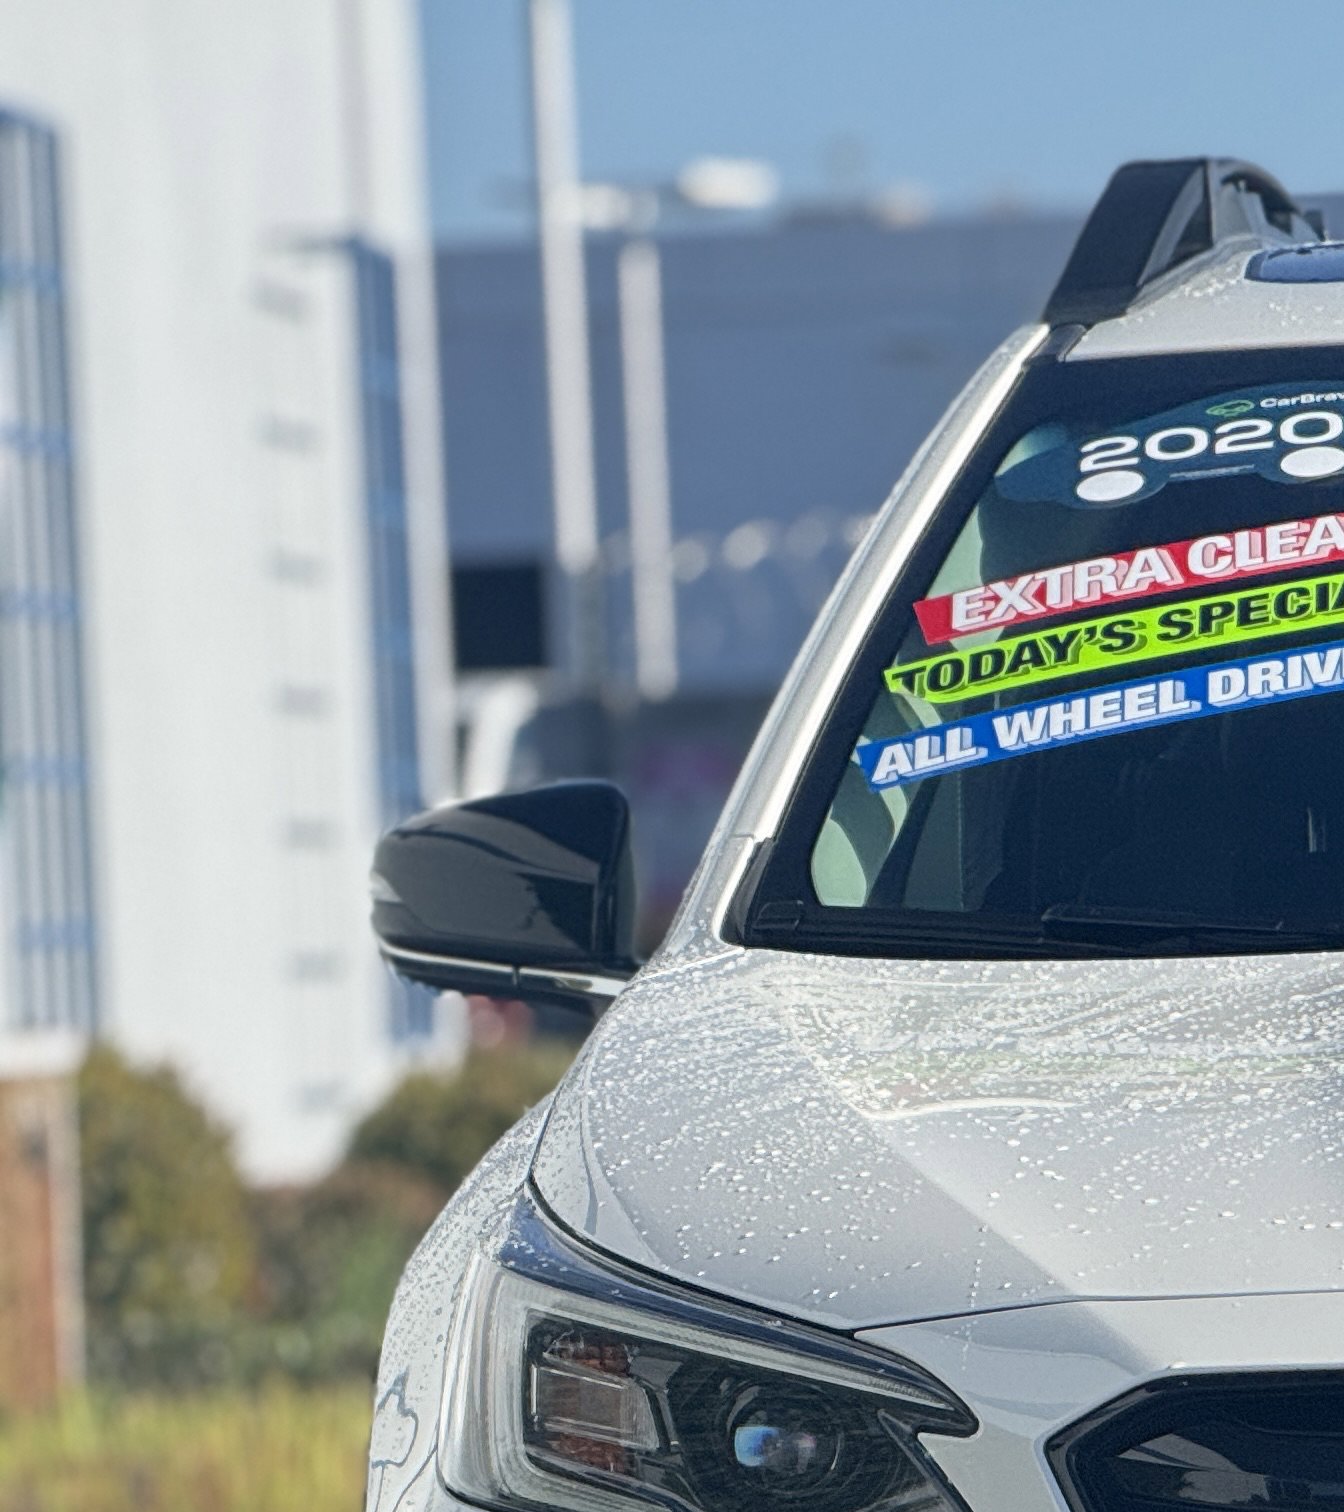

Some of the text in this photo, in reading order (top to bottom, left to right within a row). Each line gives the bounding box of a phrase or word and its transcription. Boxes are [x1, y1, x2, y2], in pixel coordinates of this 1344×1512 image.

[1079, 411, 1344, 472] 2020
[950, 547, 1180, 632] EXTRA
[892, 618, 1143, 696] TODAY'S
[871, 727, 985, 786] ALL
[992, 679, 1199, 753] WHEEL
